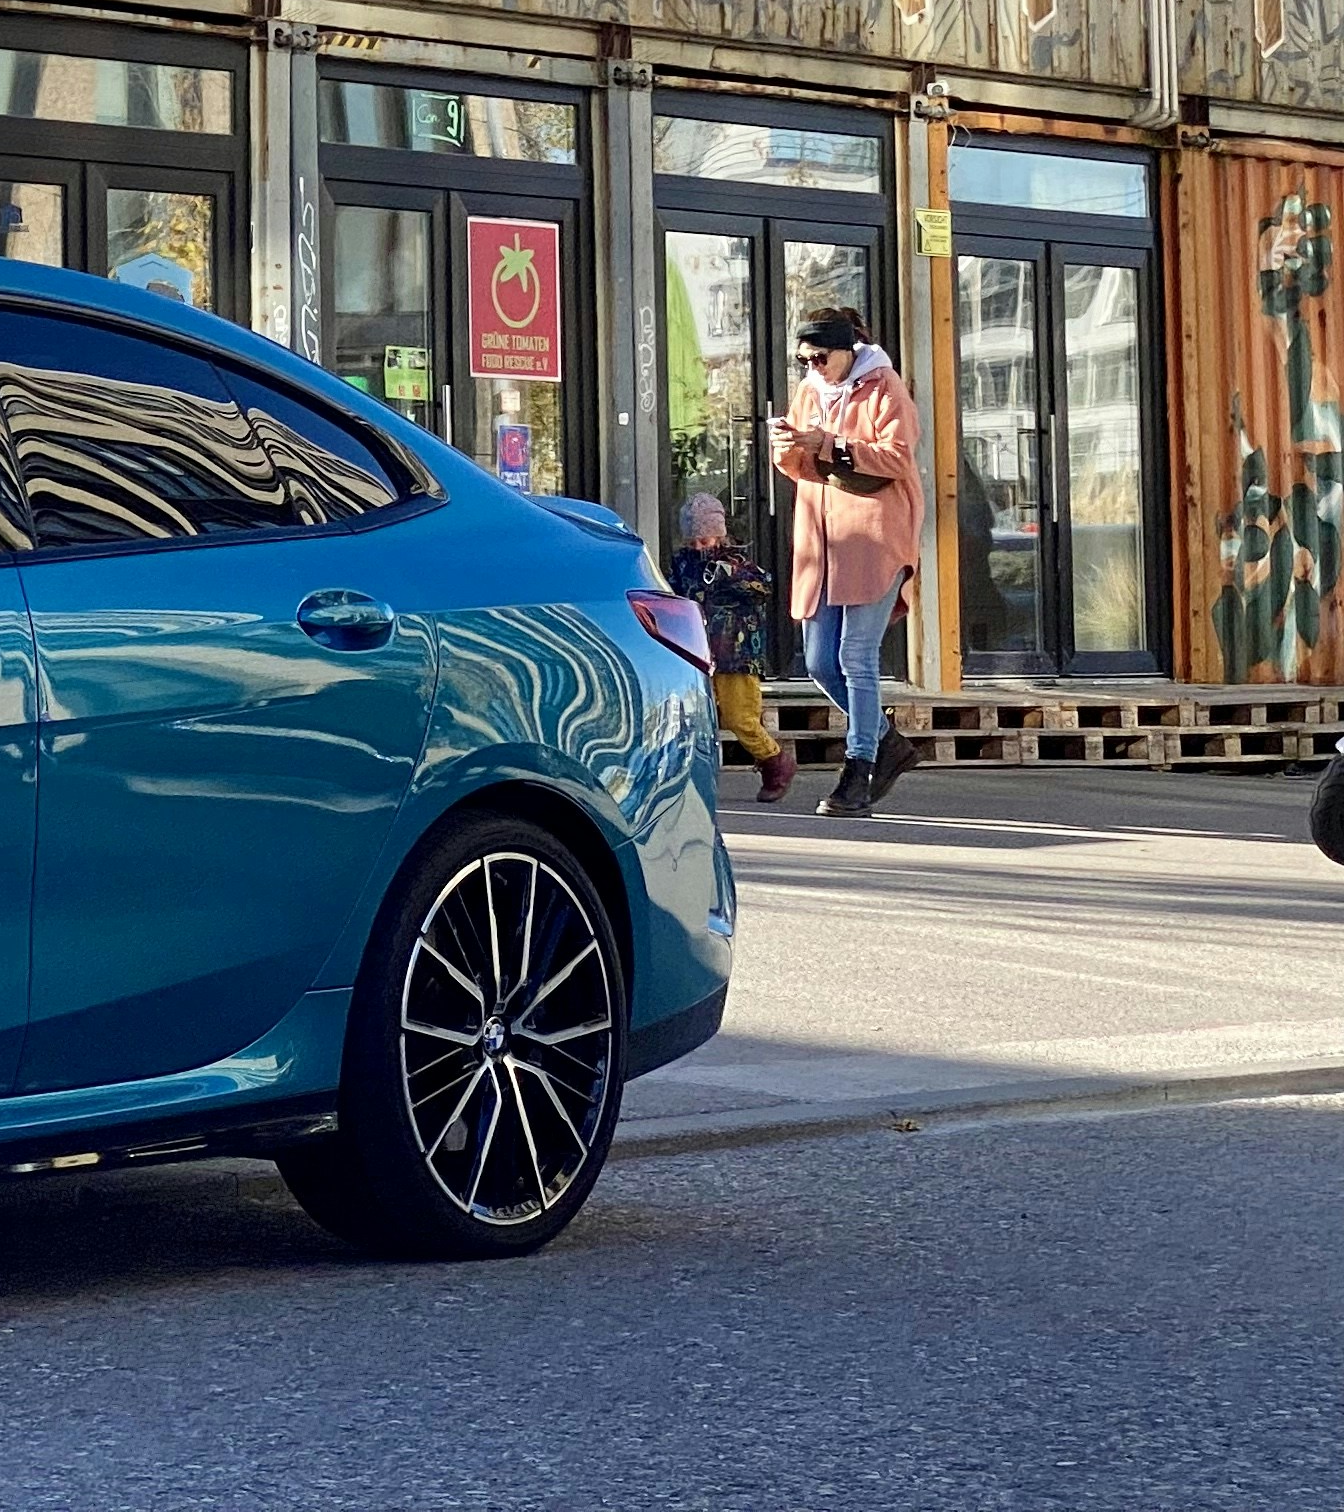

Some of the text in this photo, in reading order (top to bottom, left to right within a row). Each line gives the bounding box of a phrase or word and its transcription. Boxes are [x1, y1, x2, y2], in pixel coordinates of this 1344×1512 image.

[447, 99, 459, 138] 9
[481, 331, 549, 352] GRÜNE TOMATEN
[481, 353, 503, 369] FOOD
[504, 354, 534, 371] RESCUE
